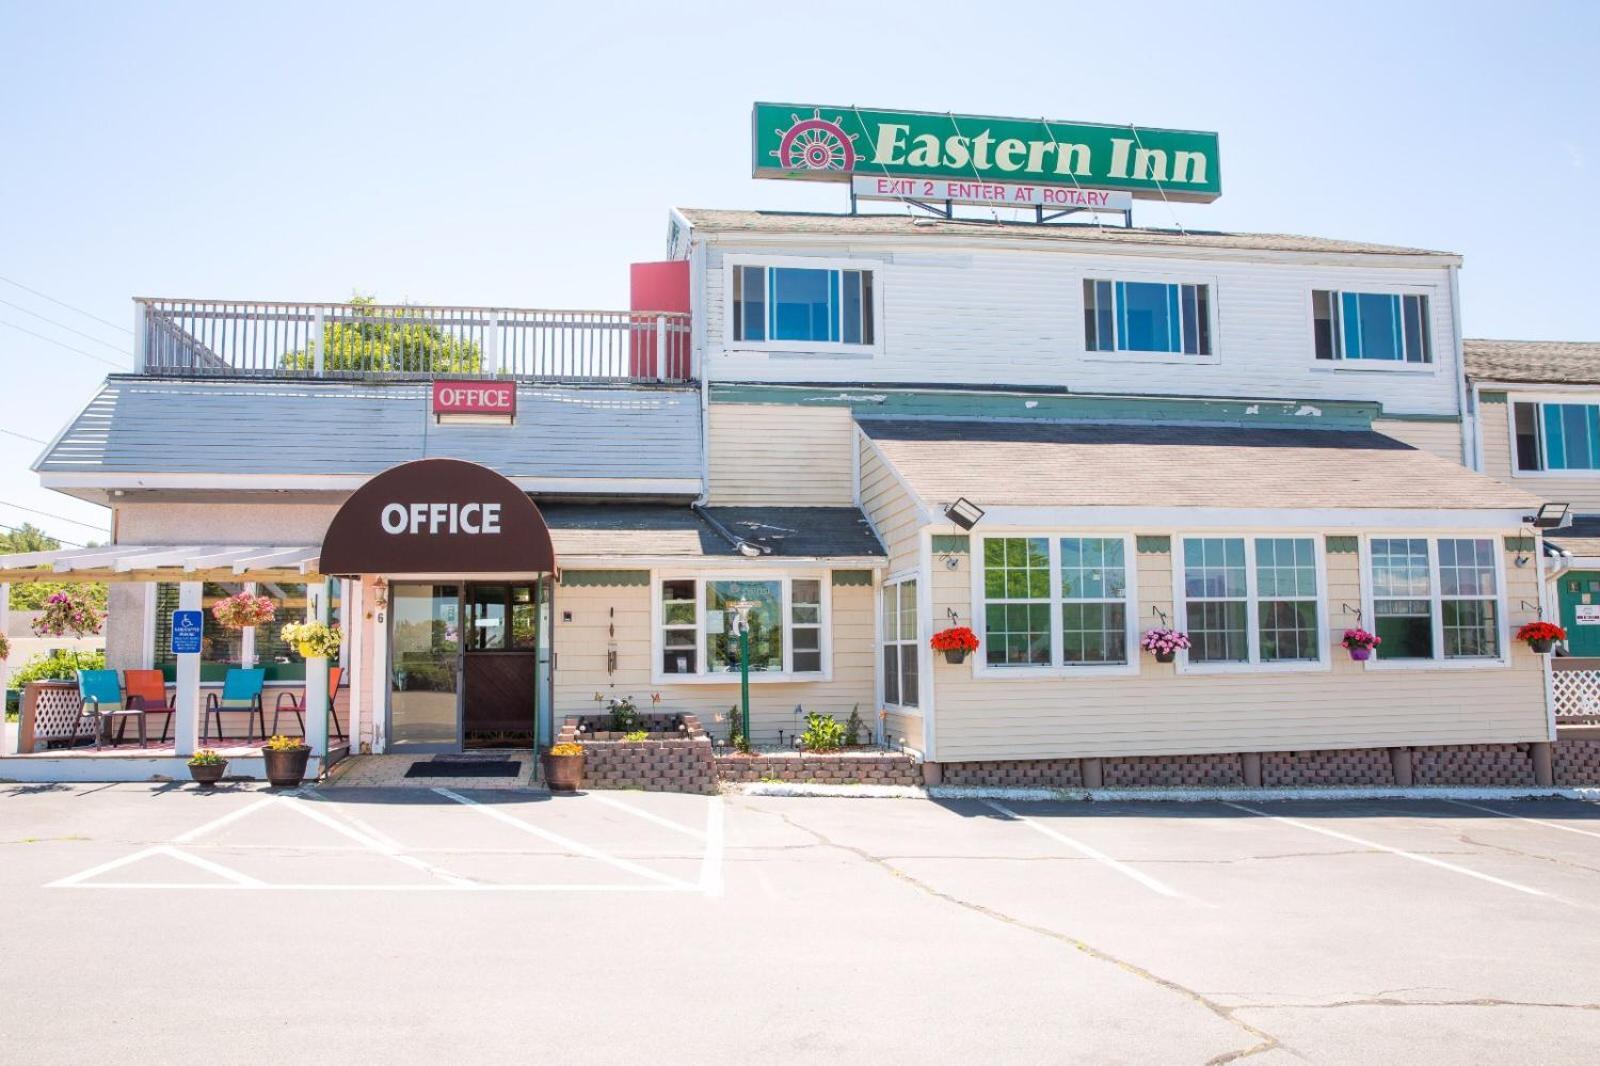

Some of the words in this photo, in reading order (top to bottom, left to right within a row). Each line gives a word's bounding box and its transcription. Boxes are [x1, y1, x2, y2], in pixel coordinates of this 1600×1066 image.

[871, 123, 1093, 177] Eastern
[1107, 138, 1209, 185] Inn
[877, 179, 919, 197] EXIT
[923, 180, 935, 197] 2
[947, 184, 1006, 202] ENTER
[1014, 186, 1035, 203] AT
[1043, 188, 1110, 207] ROTARY
[439, 388, 511, 408] OFFICE
[380, 502, 502, 536] OFFICE
[377, 612, 385, 624] 6
